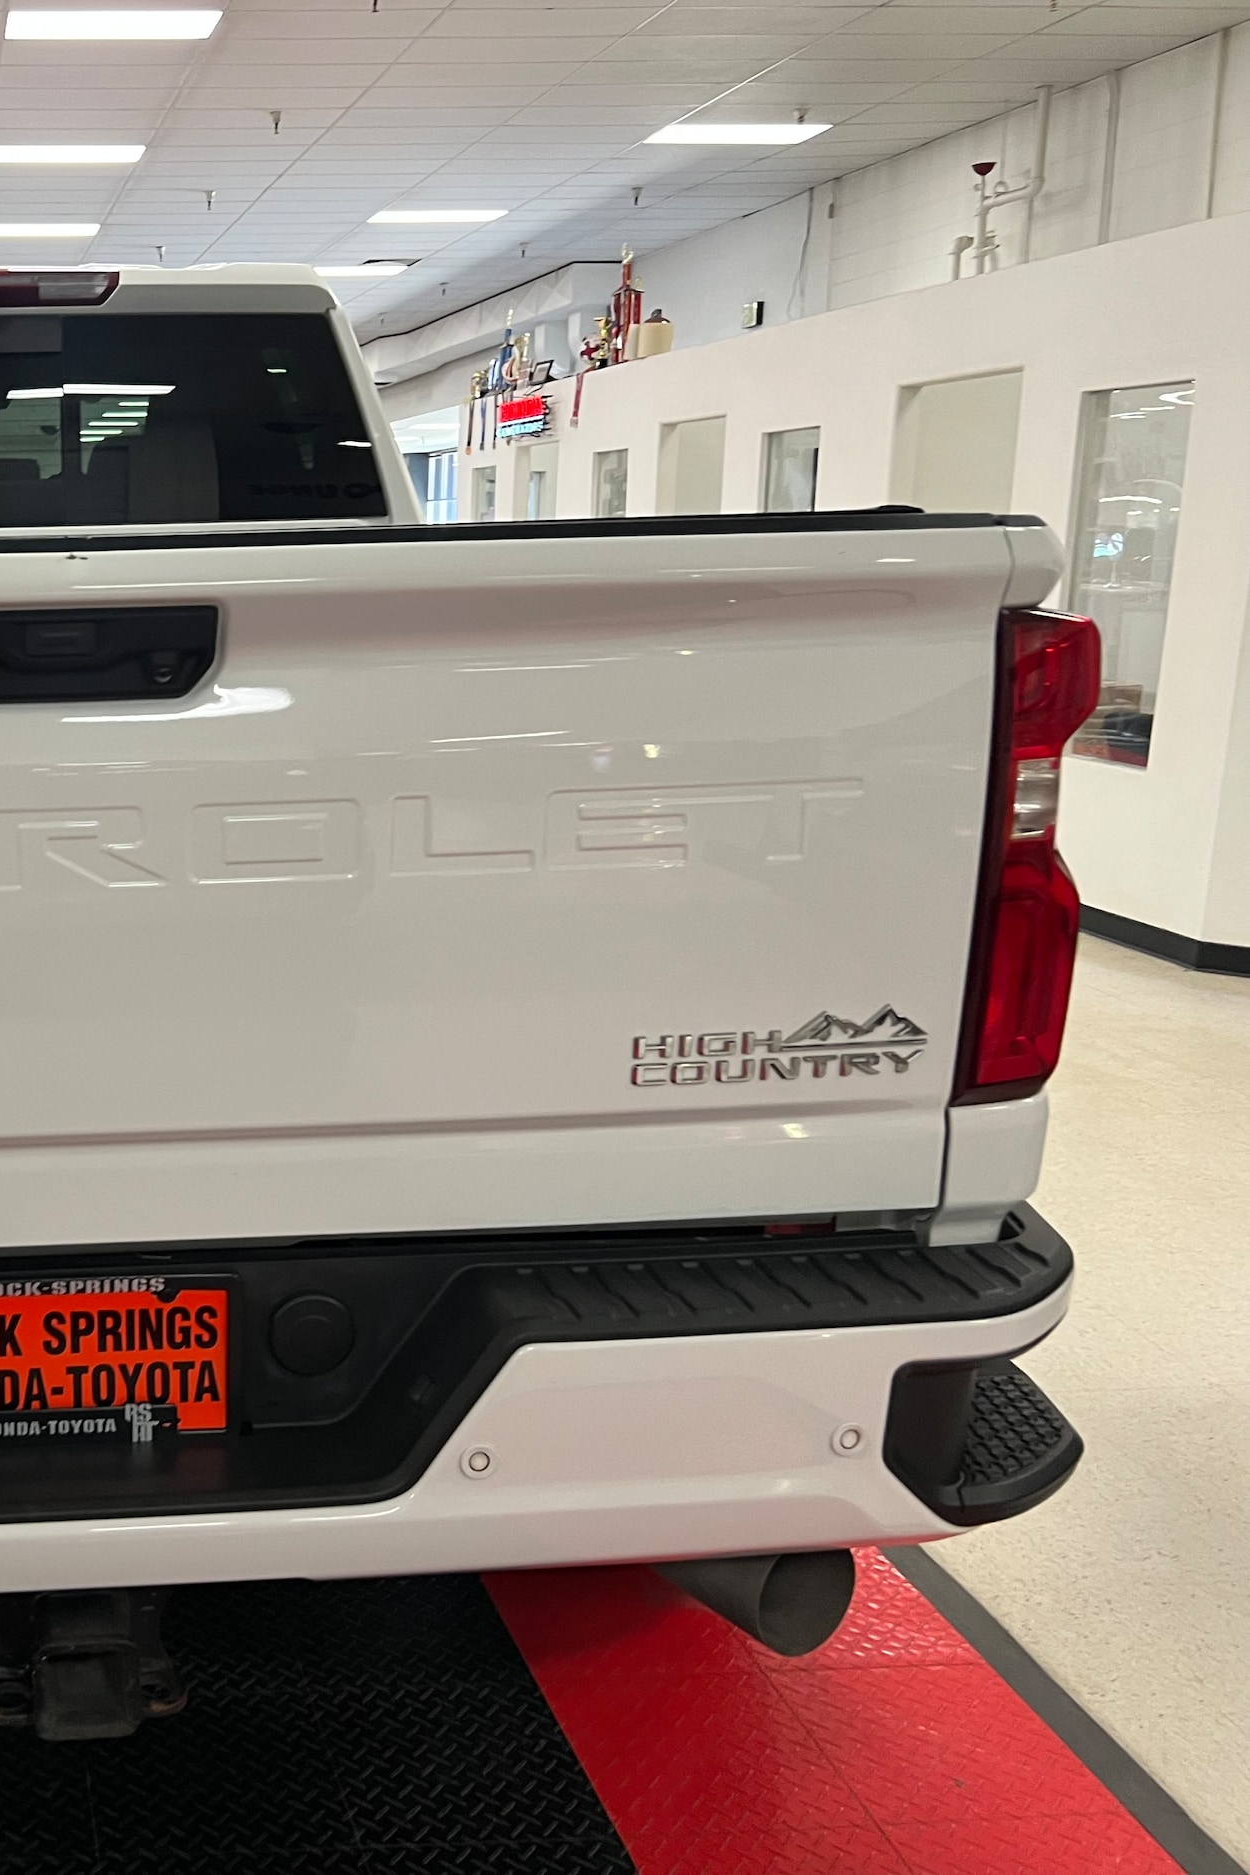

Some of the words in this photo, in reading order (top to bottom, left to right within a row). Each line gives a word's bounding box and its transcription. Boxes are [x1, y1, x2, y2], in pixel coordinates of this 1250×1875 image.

[632, 1029, 784, 1060] HIGH
[630, 1048, 926, 1087] COUNTRY
[43, 1305, 219, 1356] SPRINGS
